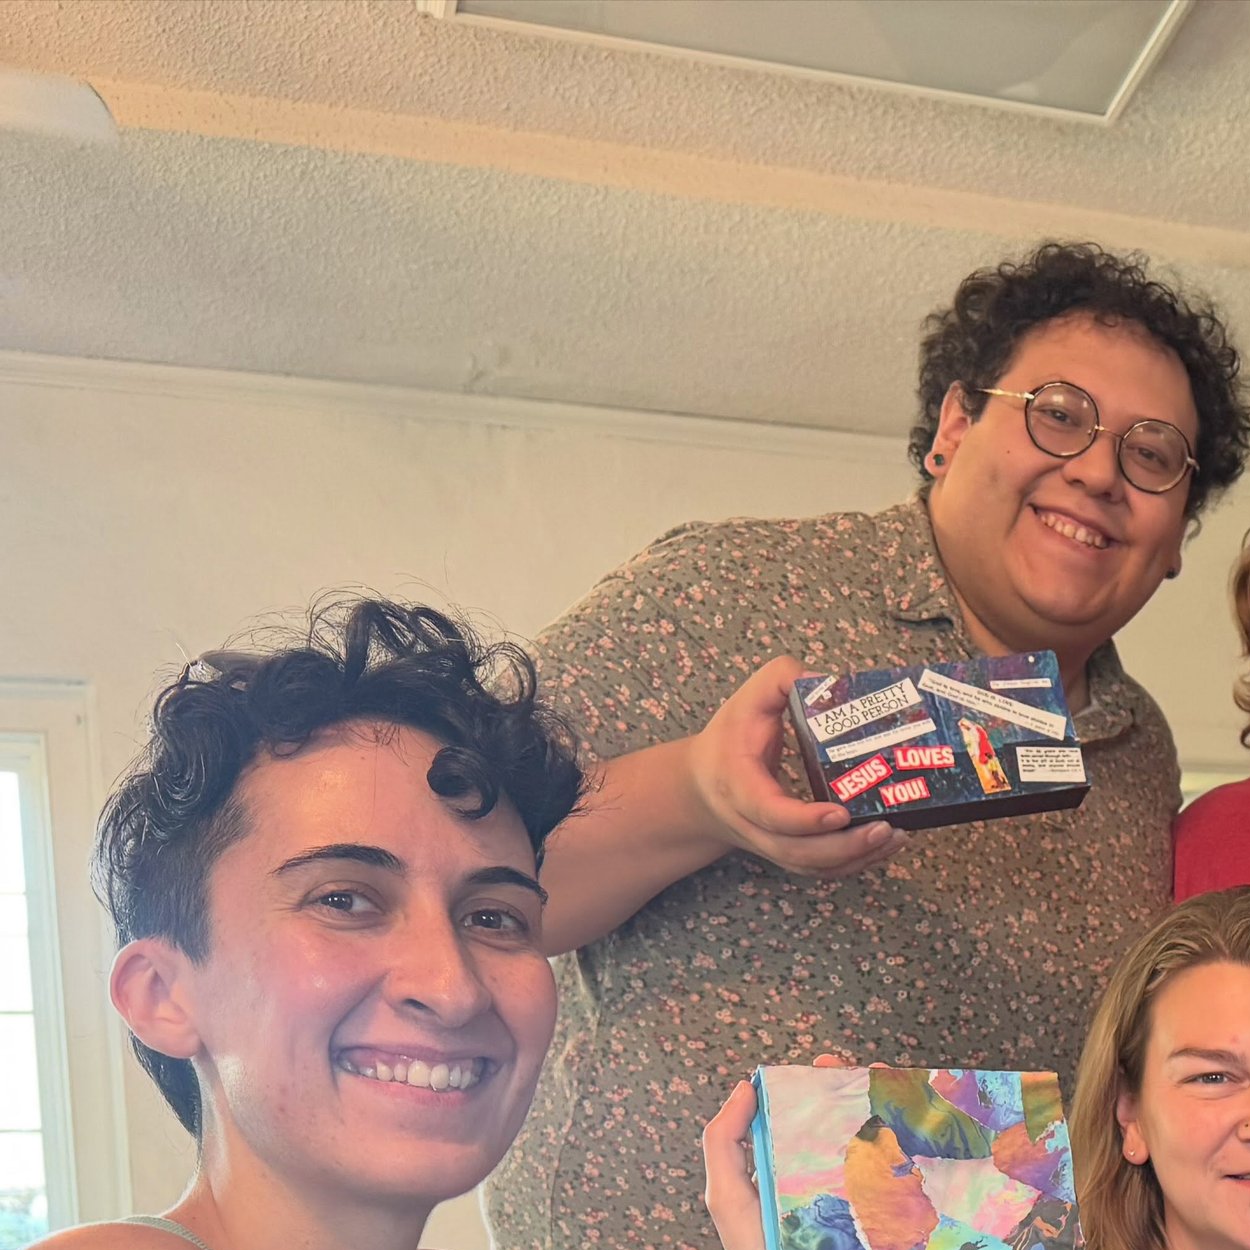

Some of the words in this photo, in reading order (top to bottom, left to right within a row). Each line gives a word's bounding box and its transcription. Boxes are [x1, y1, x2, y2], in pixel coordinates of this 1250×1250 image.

[814, 717, 821, 727] I
[825, 708, 847, 724] AM
[850, 703, 859, 714] A
[860, 683, 905, 709] PRETTY
[825, 715, 860, 735] GOOD
[861, 695, 909, 720] PERSON
[836, 759, 888, 799] JESUS
[896, 748, 954, 767] LOVES
[883, 780, 926, 805] YOU!
